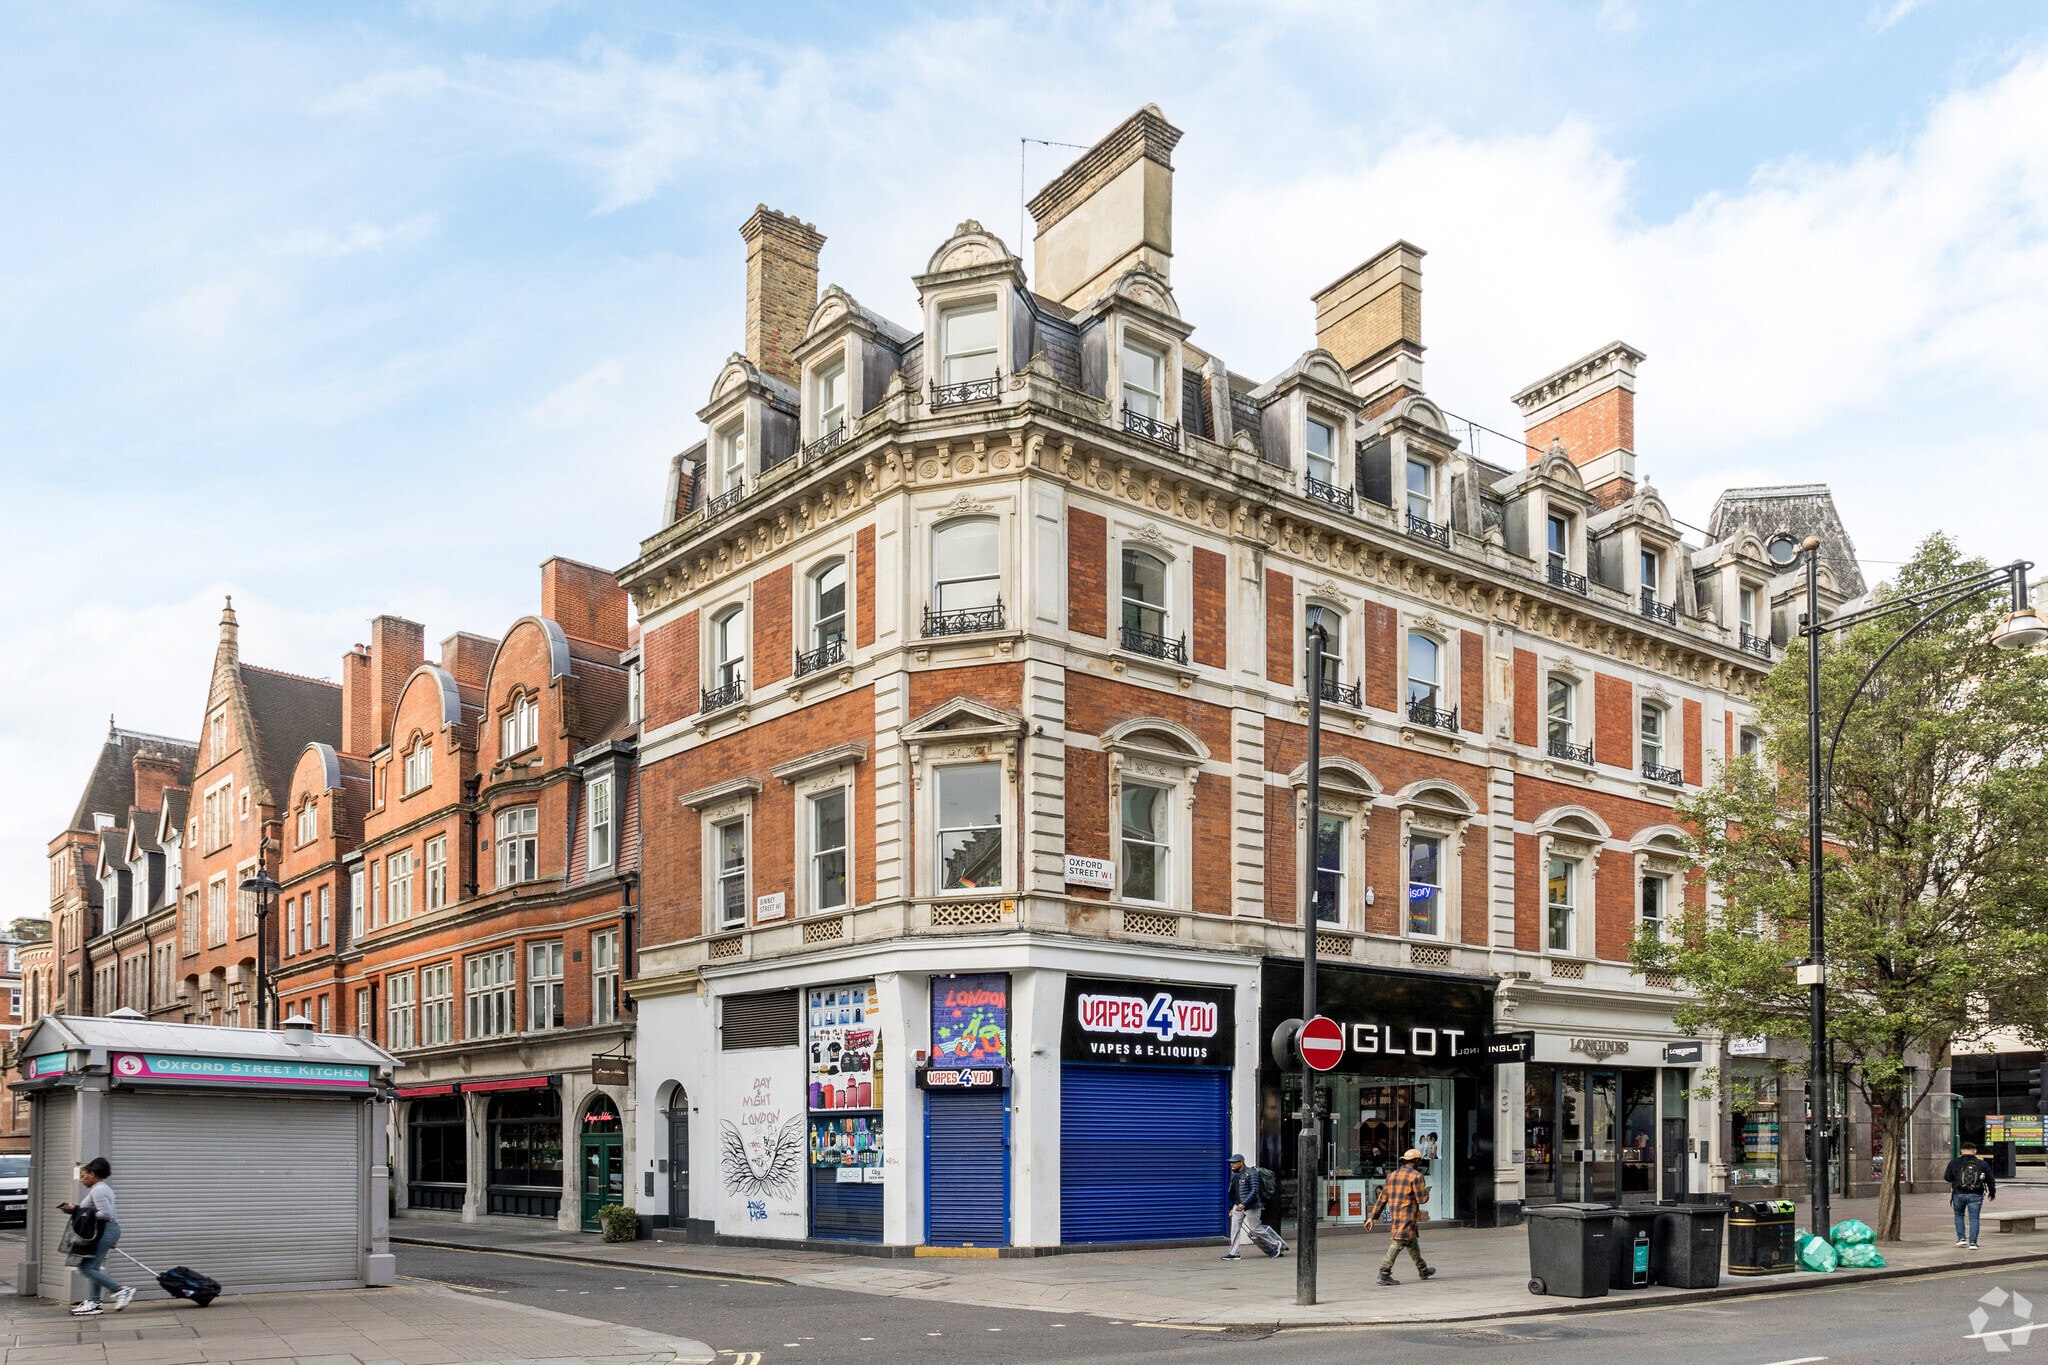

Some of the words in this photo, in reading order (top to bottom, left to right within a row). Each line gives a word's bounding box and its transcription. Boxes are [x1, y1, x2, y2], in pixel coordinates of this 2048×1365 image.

[1069, 858, 1103, 870] OXFORD
[1069, 867, 1099, 878] STREET
[759, 903, 775, 913] STREET
[1082, 999, 1143, 1029] VAPES
[1146, 997, 1174, 1037] 4
[1177, 1004, 1213, 1033] YOU
[1090, 1042, 1130, 1055] VAPES
[1134, 1044, 1143, 1055] &
[1147, 1045, 1208, 1058] E-LIQUIDS
[1488, 1043, 1526, 1053] INGLOT
[1569, 1038, 1629, 1053] LONGINES
[156, 1058, 225, 1072] OXFORD
[230, 1062, 291, 1075] STREET
[298, 1064, 364, 1078] KITCHEN
[753, 1077, 771, 1089] DAY
[928, 1072, 958, 1084] VAPES
[959, 1070, 972, 1085] 4
[972, 1073, 992, 1083] YOU
[742, 1093, 771, 1107] NIGHT
[741, 1109, 780, 1125] LONDON
